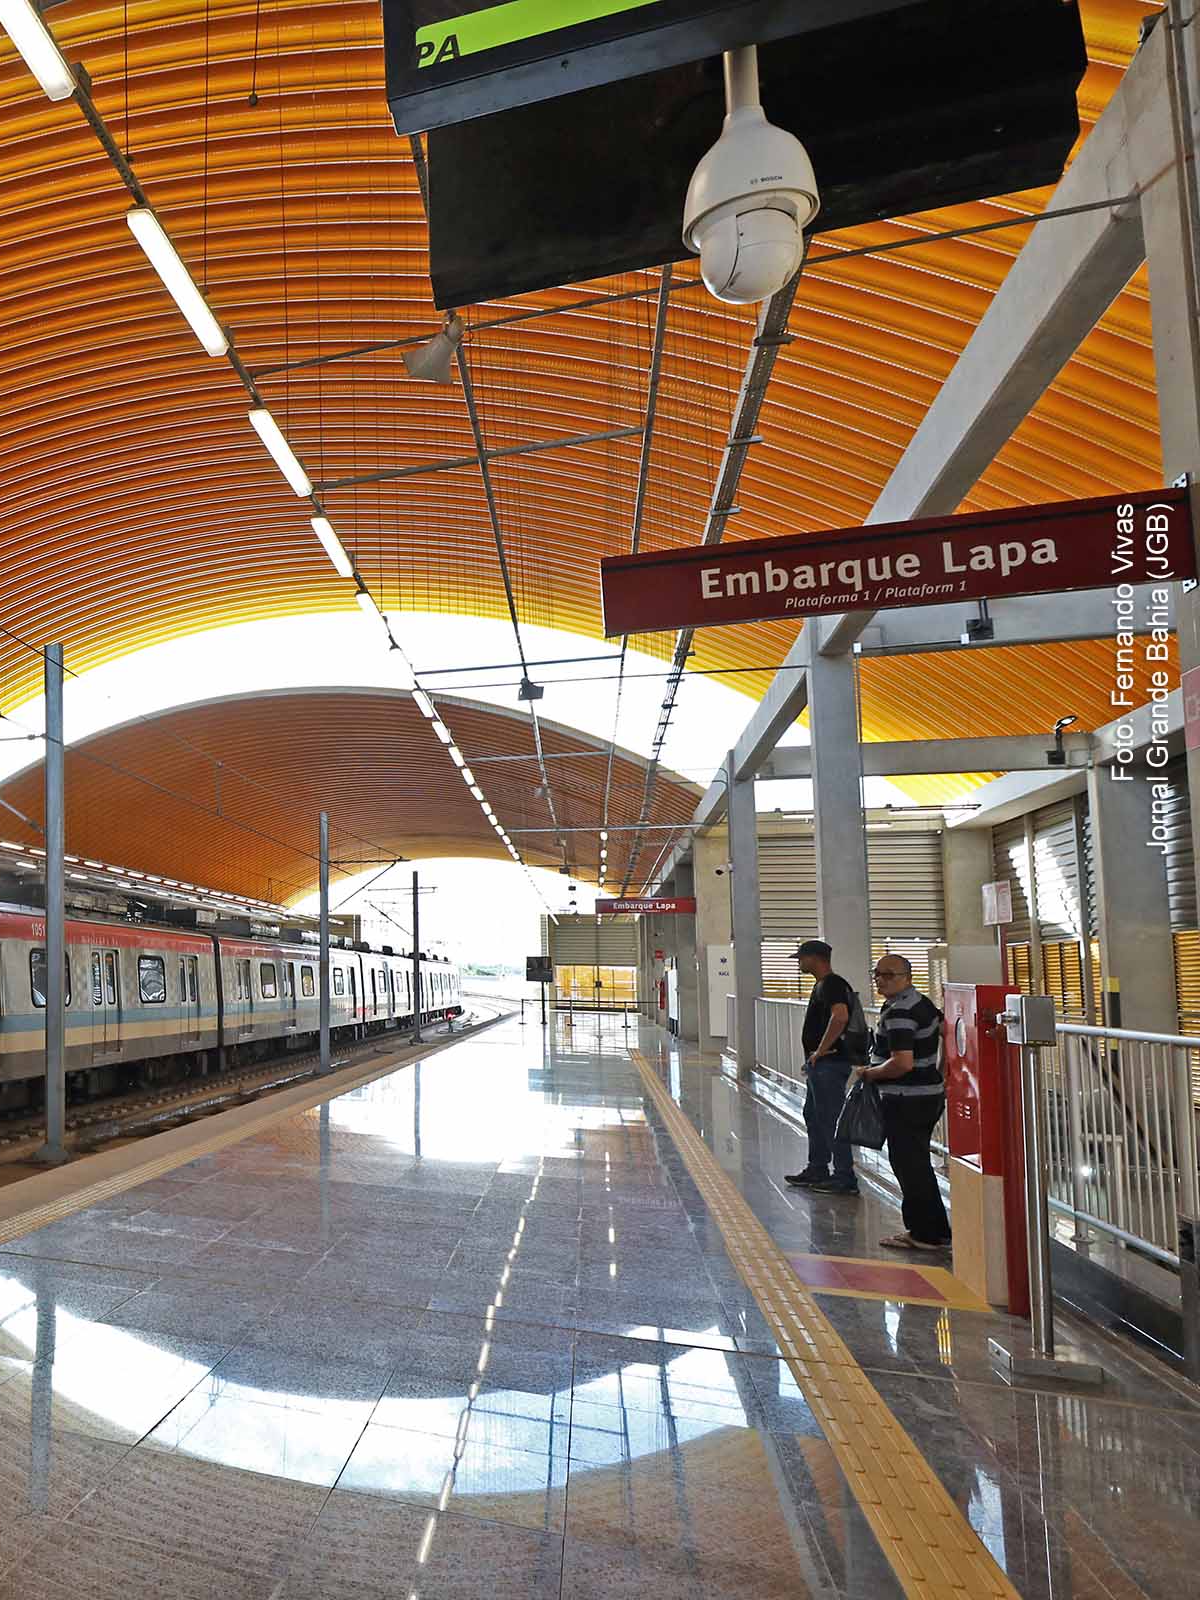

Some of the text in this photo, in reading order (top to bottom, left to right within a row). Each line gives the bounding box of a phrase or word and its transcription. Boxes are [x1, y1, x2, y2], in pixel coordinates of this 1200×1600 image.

[700, 538, 1058, 600] Embarque Lapa
[785, 580, 967, 609] Plataforma 1 / Plataform 1
[613, 902, 653, 912] Embarque
[655, 902, 676, 911] Lapa
